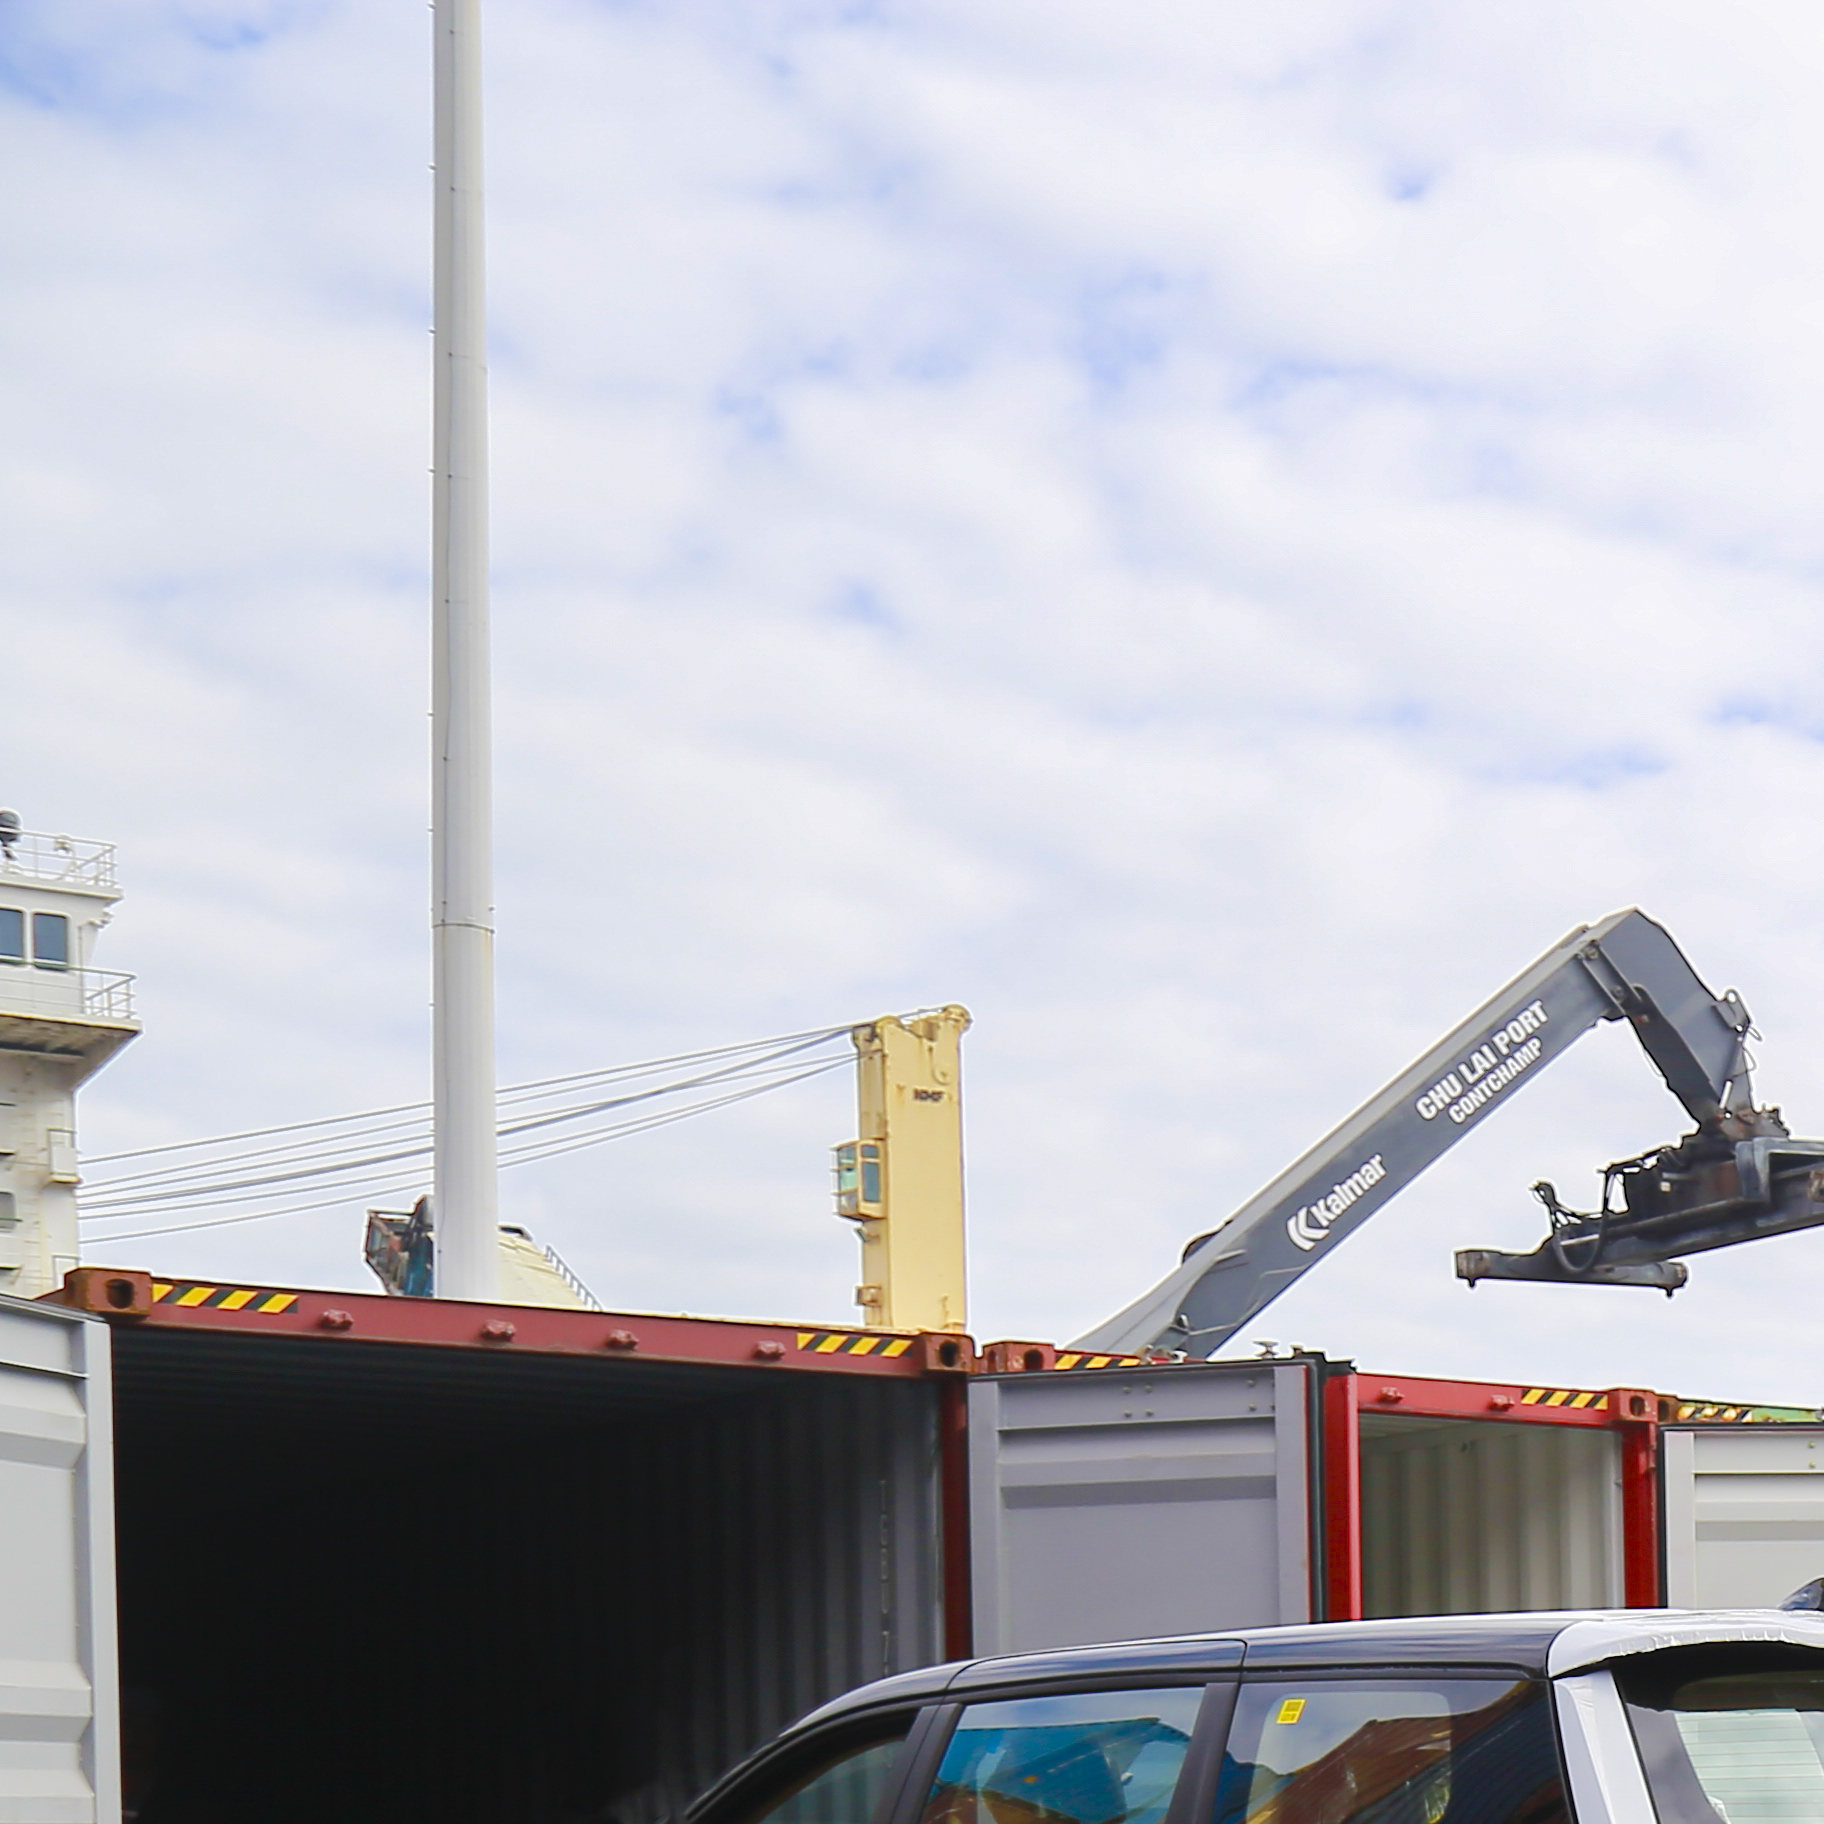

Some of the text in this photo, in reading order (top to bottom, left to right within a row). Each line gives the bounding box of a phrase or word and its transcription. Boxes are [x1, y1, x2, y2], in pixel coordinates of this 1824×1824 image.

[1415, 999, 1549, 1121] CHU LAI PORT
[1448, 1037, 1542, 1124] CONTCHAMP
[1309, 1153, 1387, 1228] Kalmar
